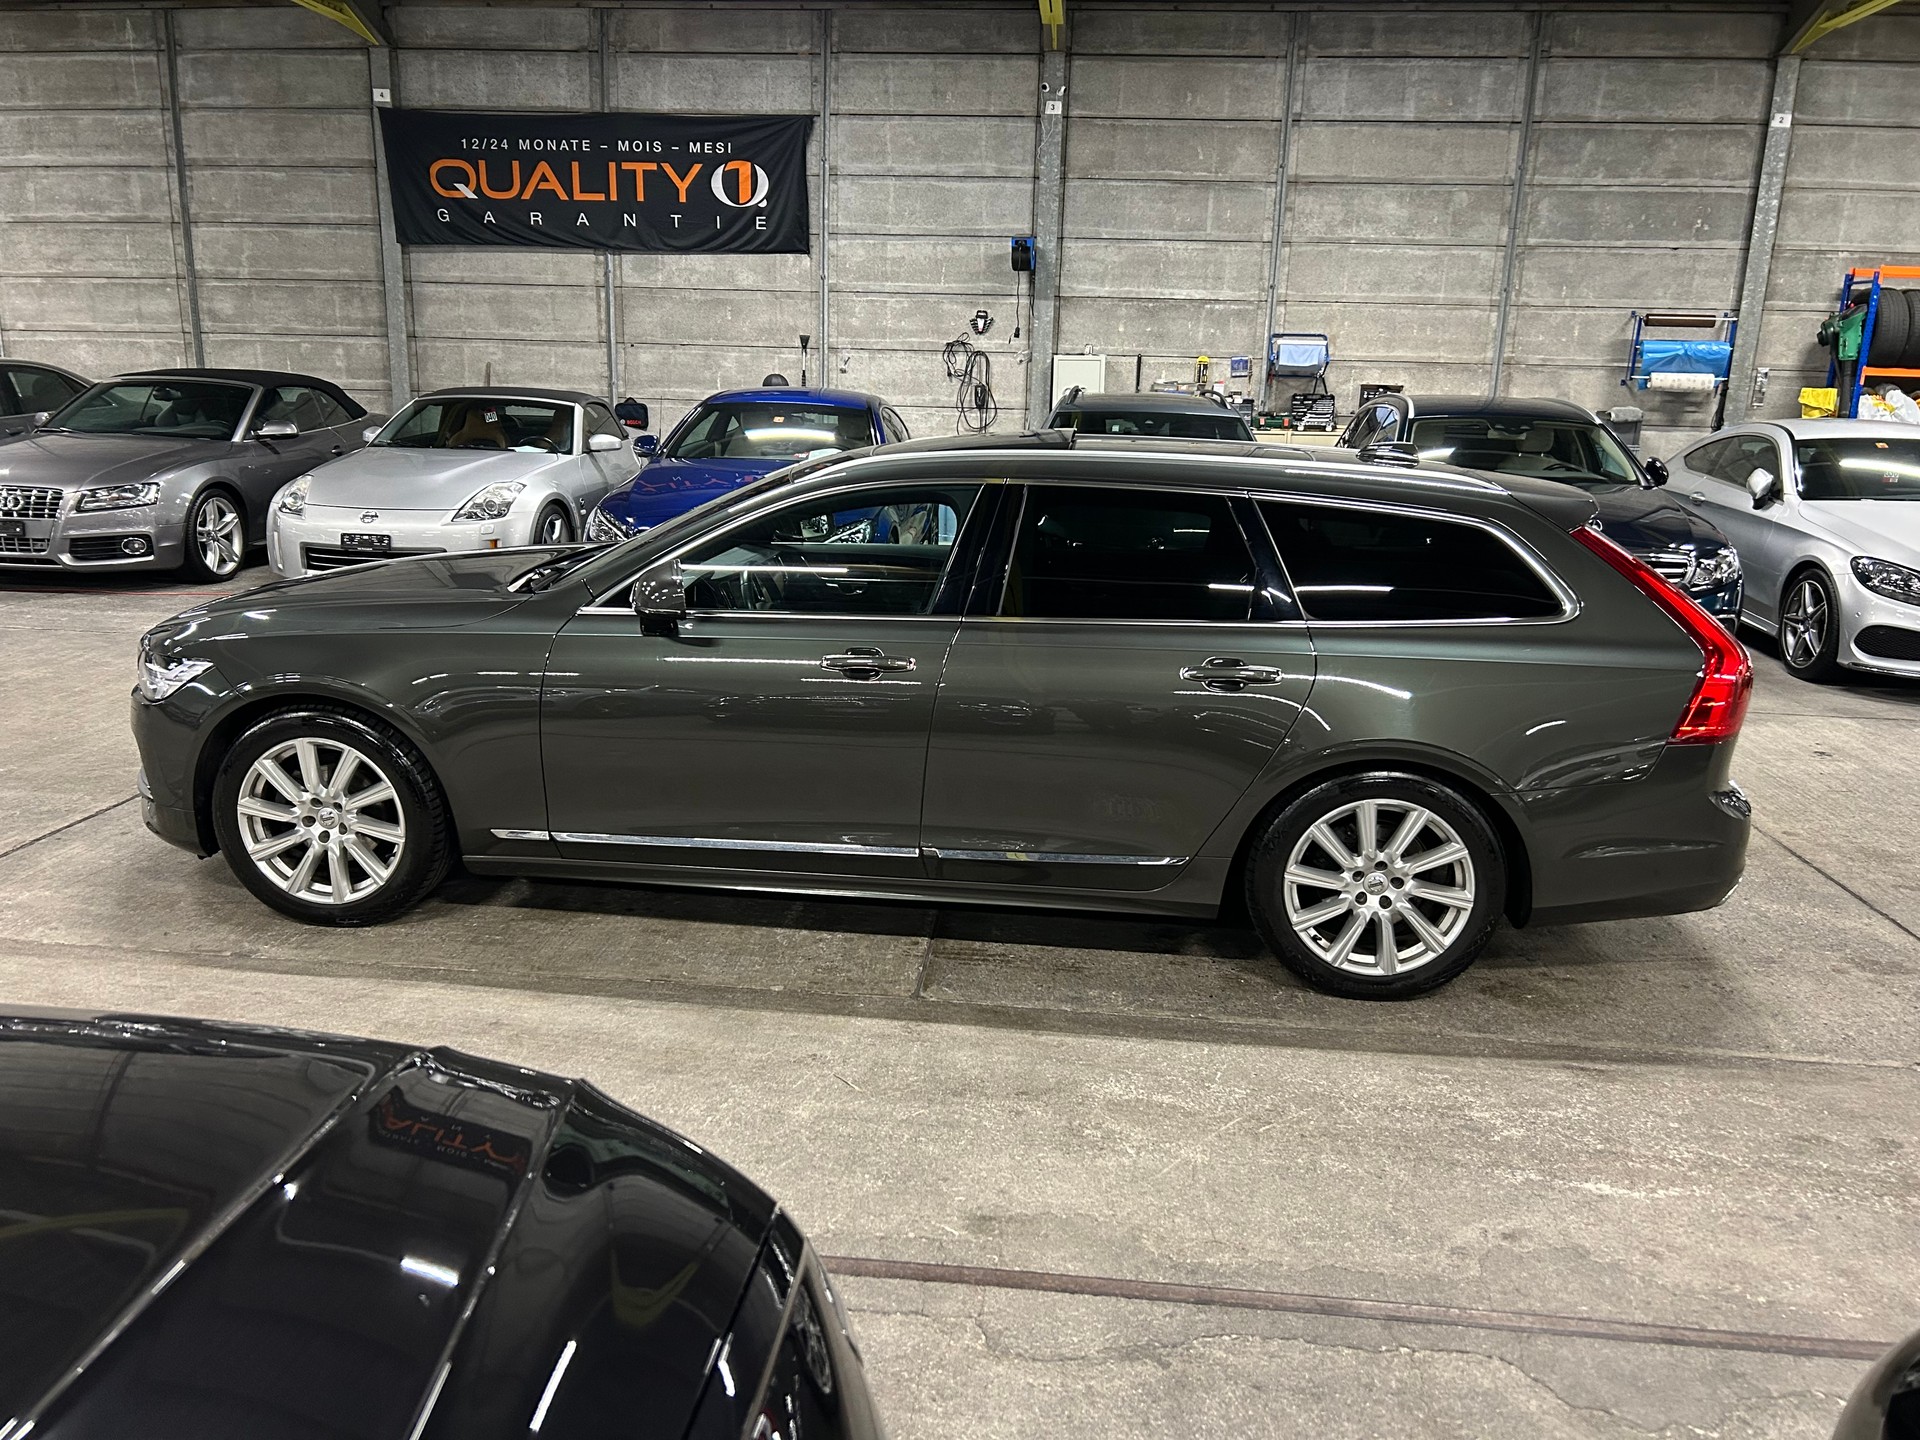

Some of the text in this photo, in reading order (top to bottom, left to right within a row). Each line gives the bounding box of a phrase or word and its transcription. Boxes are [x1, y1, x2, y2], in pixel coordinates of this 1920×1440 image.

[461, 138, 509, 150] 12/24
[518, 139, 591, 151] MONATE
[617, 140, 662, 152] MOIS
[689, 141, 732, 154] MESI
[429, 158, 703, 203] QUALITY
[437, 208, 767, 230] GARANTIE
